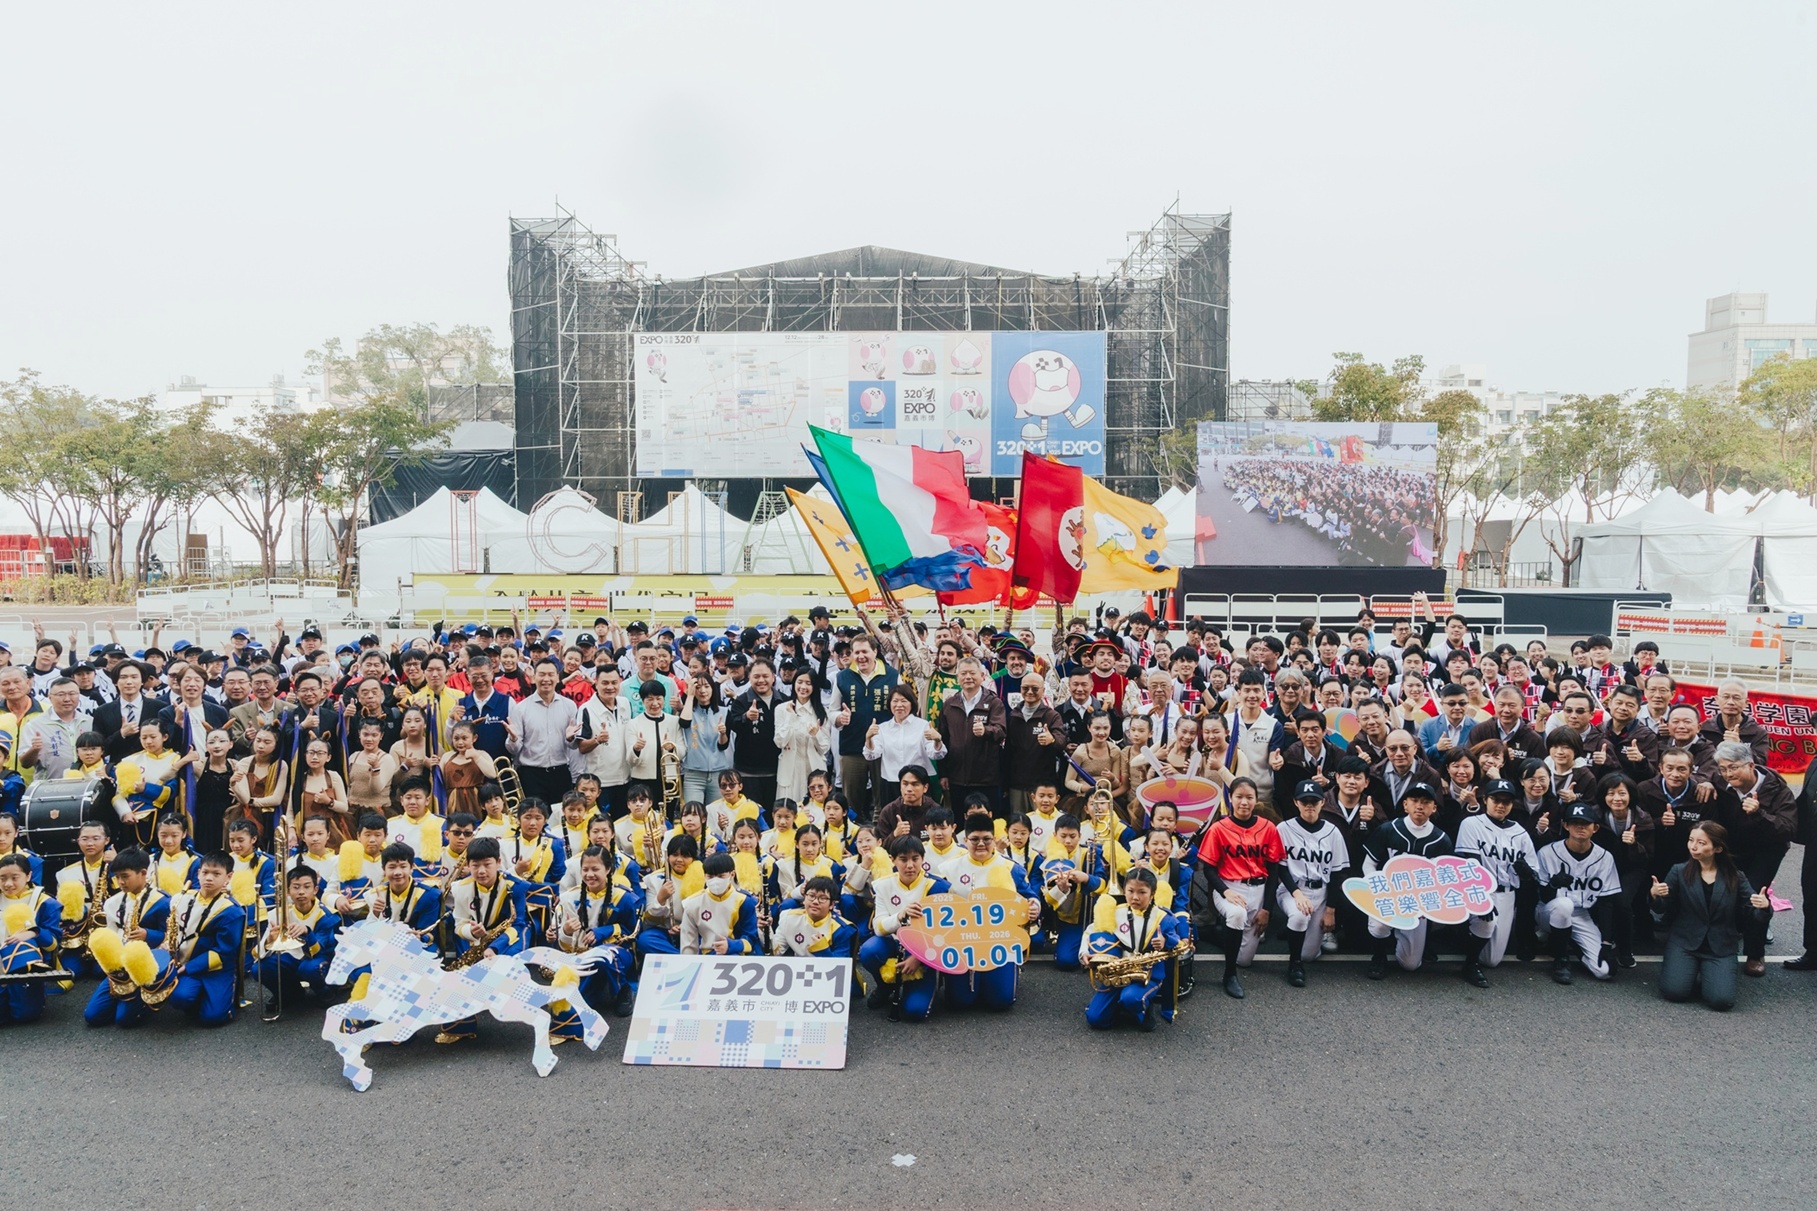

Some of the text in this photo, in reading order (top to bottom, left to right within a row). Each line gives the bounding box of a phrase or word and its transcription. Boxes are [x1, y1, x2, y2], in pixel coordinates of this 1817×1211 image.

[640, 336, 663, 344] EXPO
[904, 403, 935, 413] EXPO
[1063, 440, 1102, 455] EXPO
[527, 487, 828, 573] CHIA
[1704, 696, 1812, 726] 奈学園
[1795, 728, 1815, 736] UN
[1802, 739, 1817, 755] B
[1498, 781, 1509, 789] K
[1573, 806, 1584, 815] K
[1285, 846, 1333, 864] KANO
[1368, 862, 1482, 894] 我們嘉義式
[933, 894, 954, 902] 2025
[1374, 885, 1486, 916] 管樂響全市
[1587, 894, 1594, 902] 4
[922, 904, 1005, 928] 12.19
[960, 931, 1010, 940] THU. 2026
[942, 944, 1023, 969] 01.01
[706, 998, 756, 1013] 嘉義市
[785, 1000, 798, 1013] 博
[803, 1001, 845, 1014] EXPO
